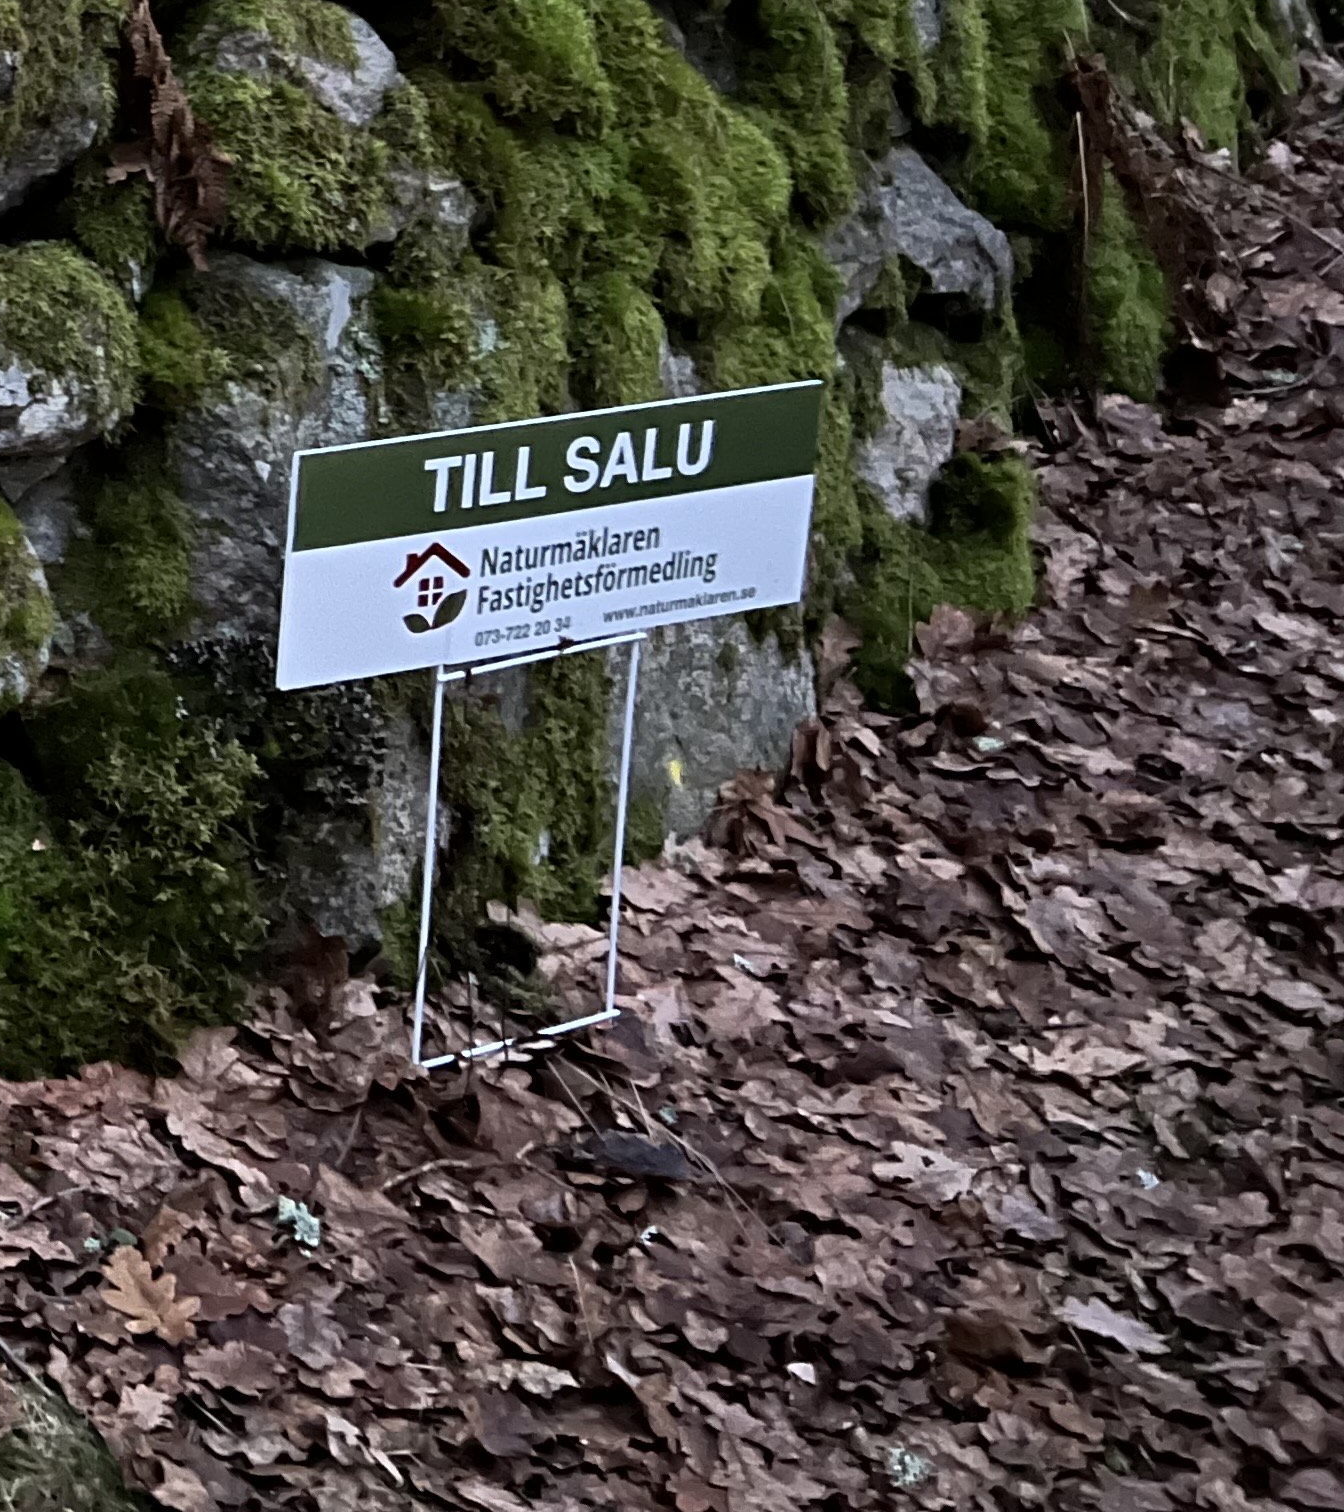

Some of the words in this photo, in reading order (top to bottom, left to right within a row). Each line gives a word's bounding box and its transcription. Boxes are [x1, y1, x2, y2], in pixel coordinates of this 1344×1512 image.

[424, 447, 546, 513] TILL
[563, 419, 716, 494] SALU
[479, 525, 661, 578] Naturmäklaren
[476, 551, 718, 615] Fastighetsförmedling
[602, 586, 757, 623] www.naturmaklaren.se
[474, 620, 531, 647] 073-722
[533, 619, 552, 637] 20
